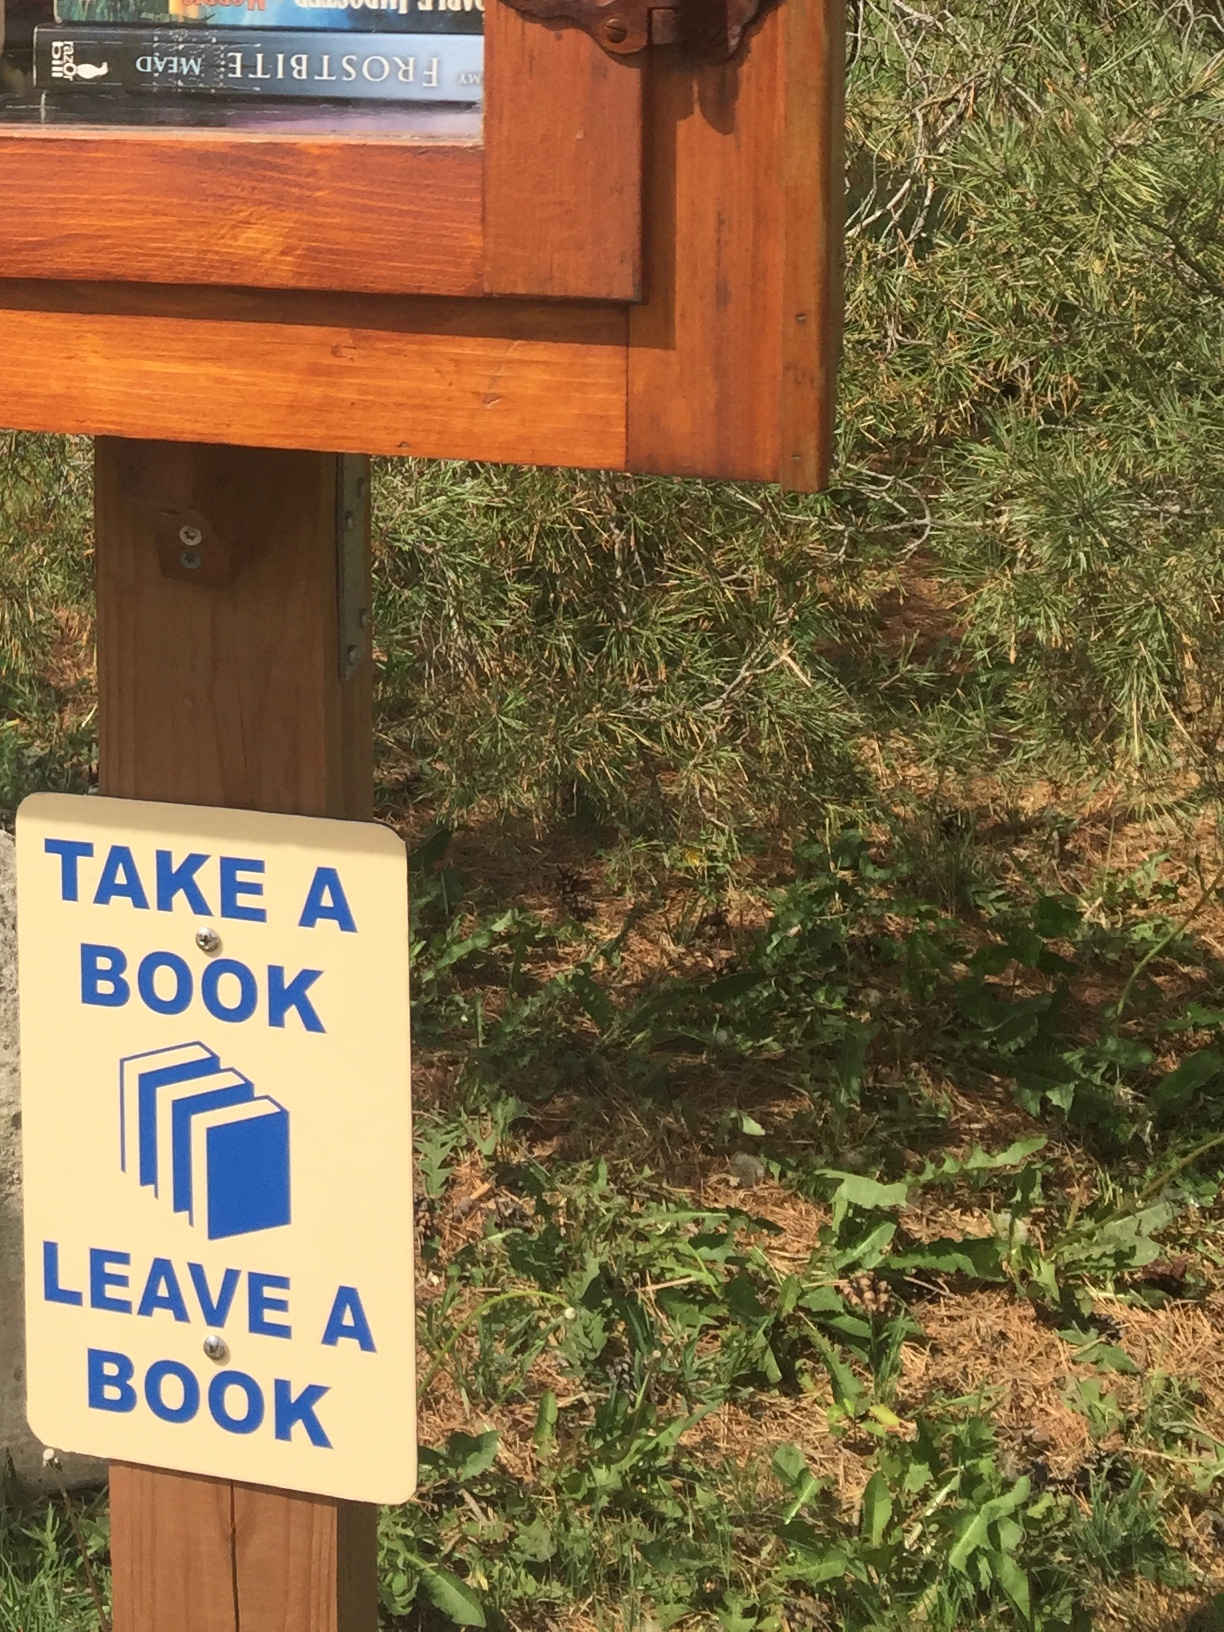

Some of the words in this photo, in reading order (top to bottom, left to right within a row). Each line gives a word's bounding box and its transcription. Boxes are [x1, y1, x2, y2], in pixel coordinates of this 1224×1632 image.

[51, 41, 64, 78] bill
[135, 54, 203, 76] MEAD
[228, 51, 439, 88] FROSTBITE
[43, 838, 268, 924] TAKE
[297, 866, 358, 933] A
[79, 942, 328, 1034] BOOK
[42, 1240, 293, 1341] LEAVE
[321, 1284, 377, 1353] A
[86, 1347, 335, 1450] BOOK
